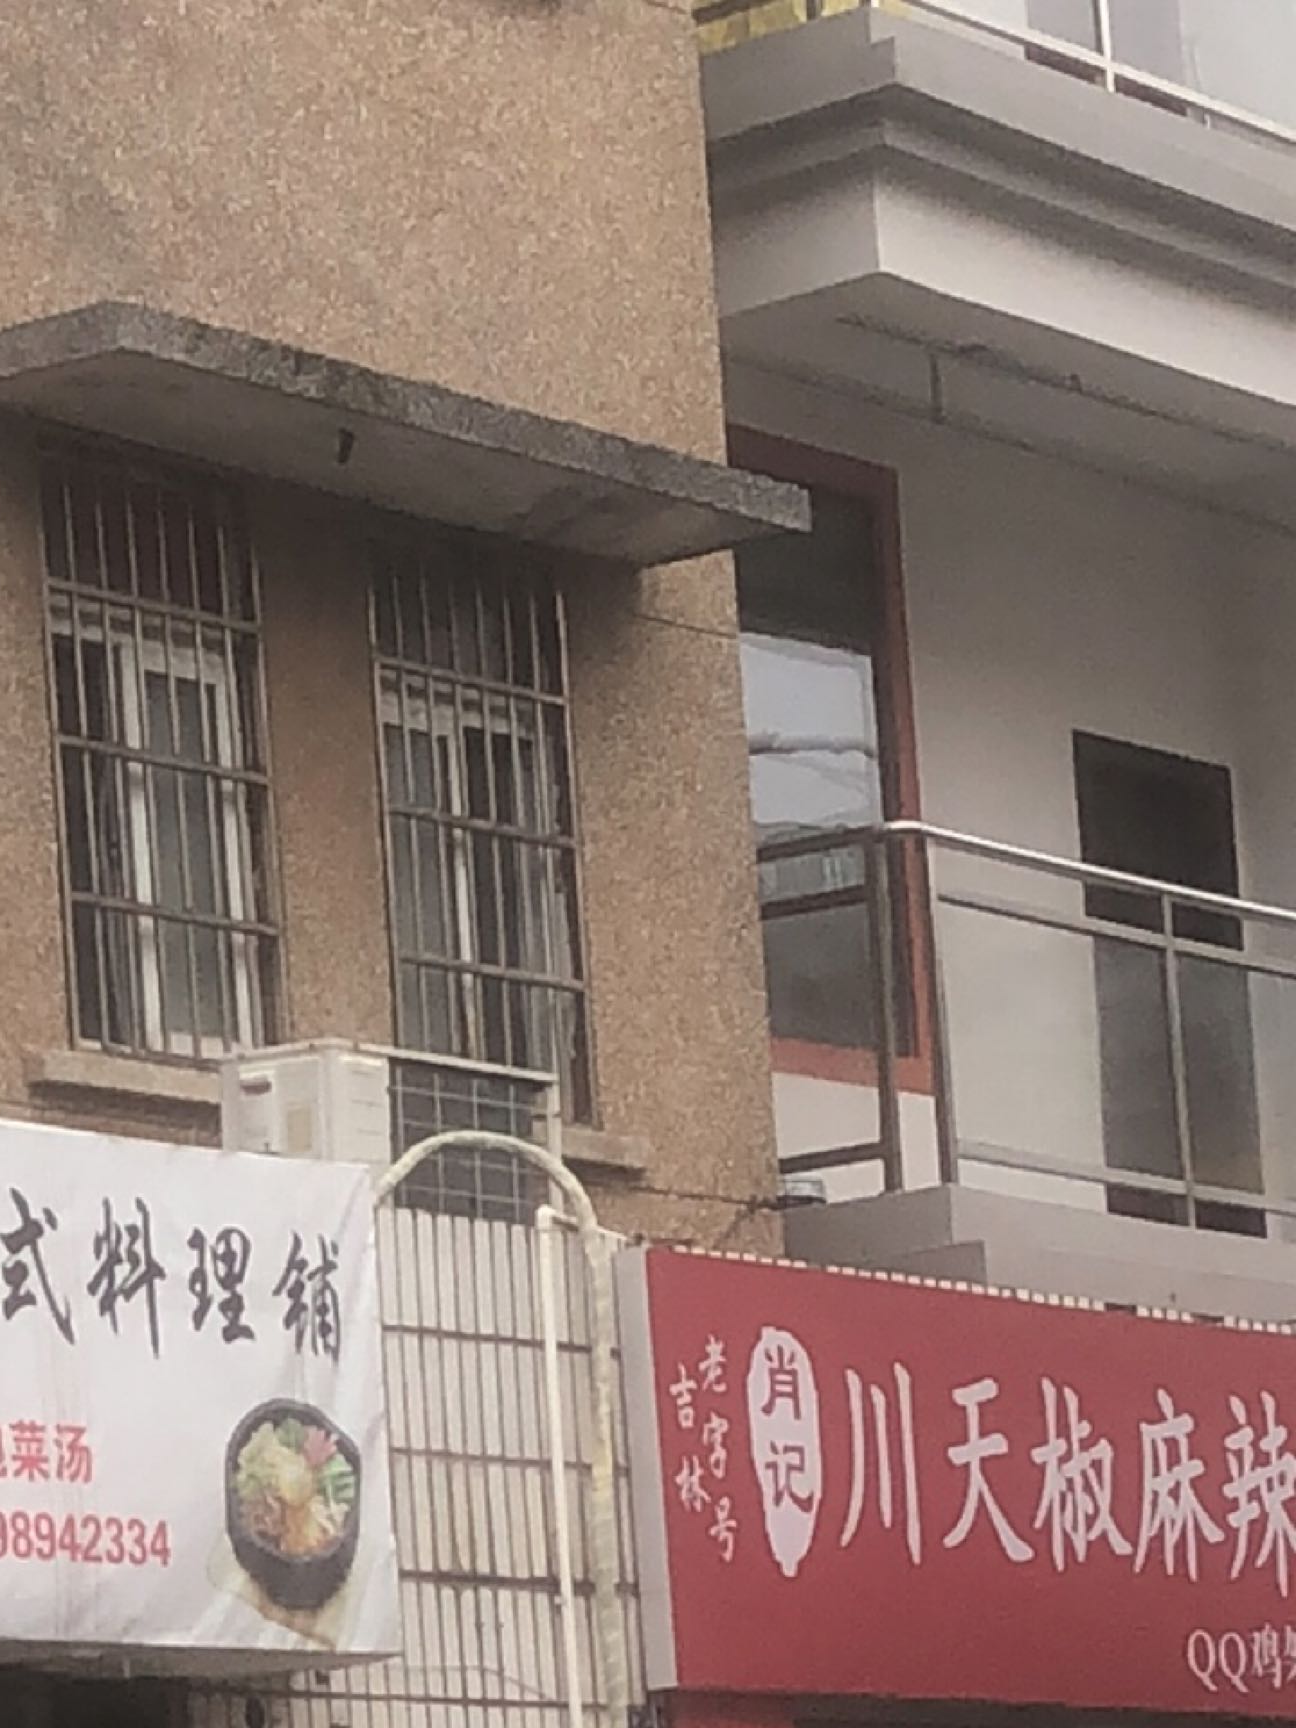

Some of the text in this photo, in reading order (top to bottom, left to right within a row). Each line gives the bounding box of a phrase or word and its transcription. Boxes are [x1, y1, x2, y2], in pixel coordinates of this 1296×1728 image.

[669, 1362, 712, 1513] 吉林
[761, 1344, 815, 1514] 肖记
[840, 1361, 1296, 1598] 川天椒麻辣
